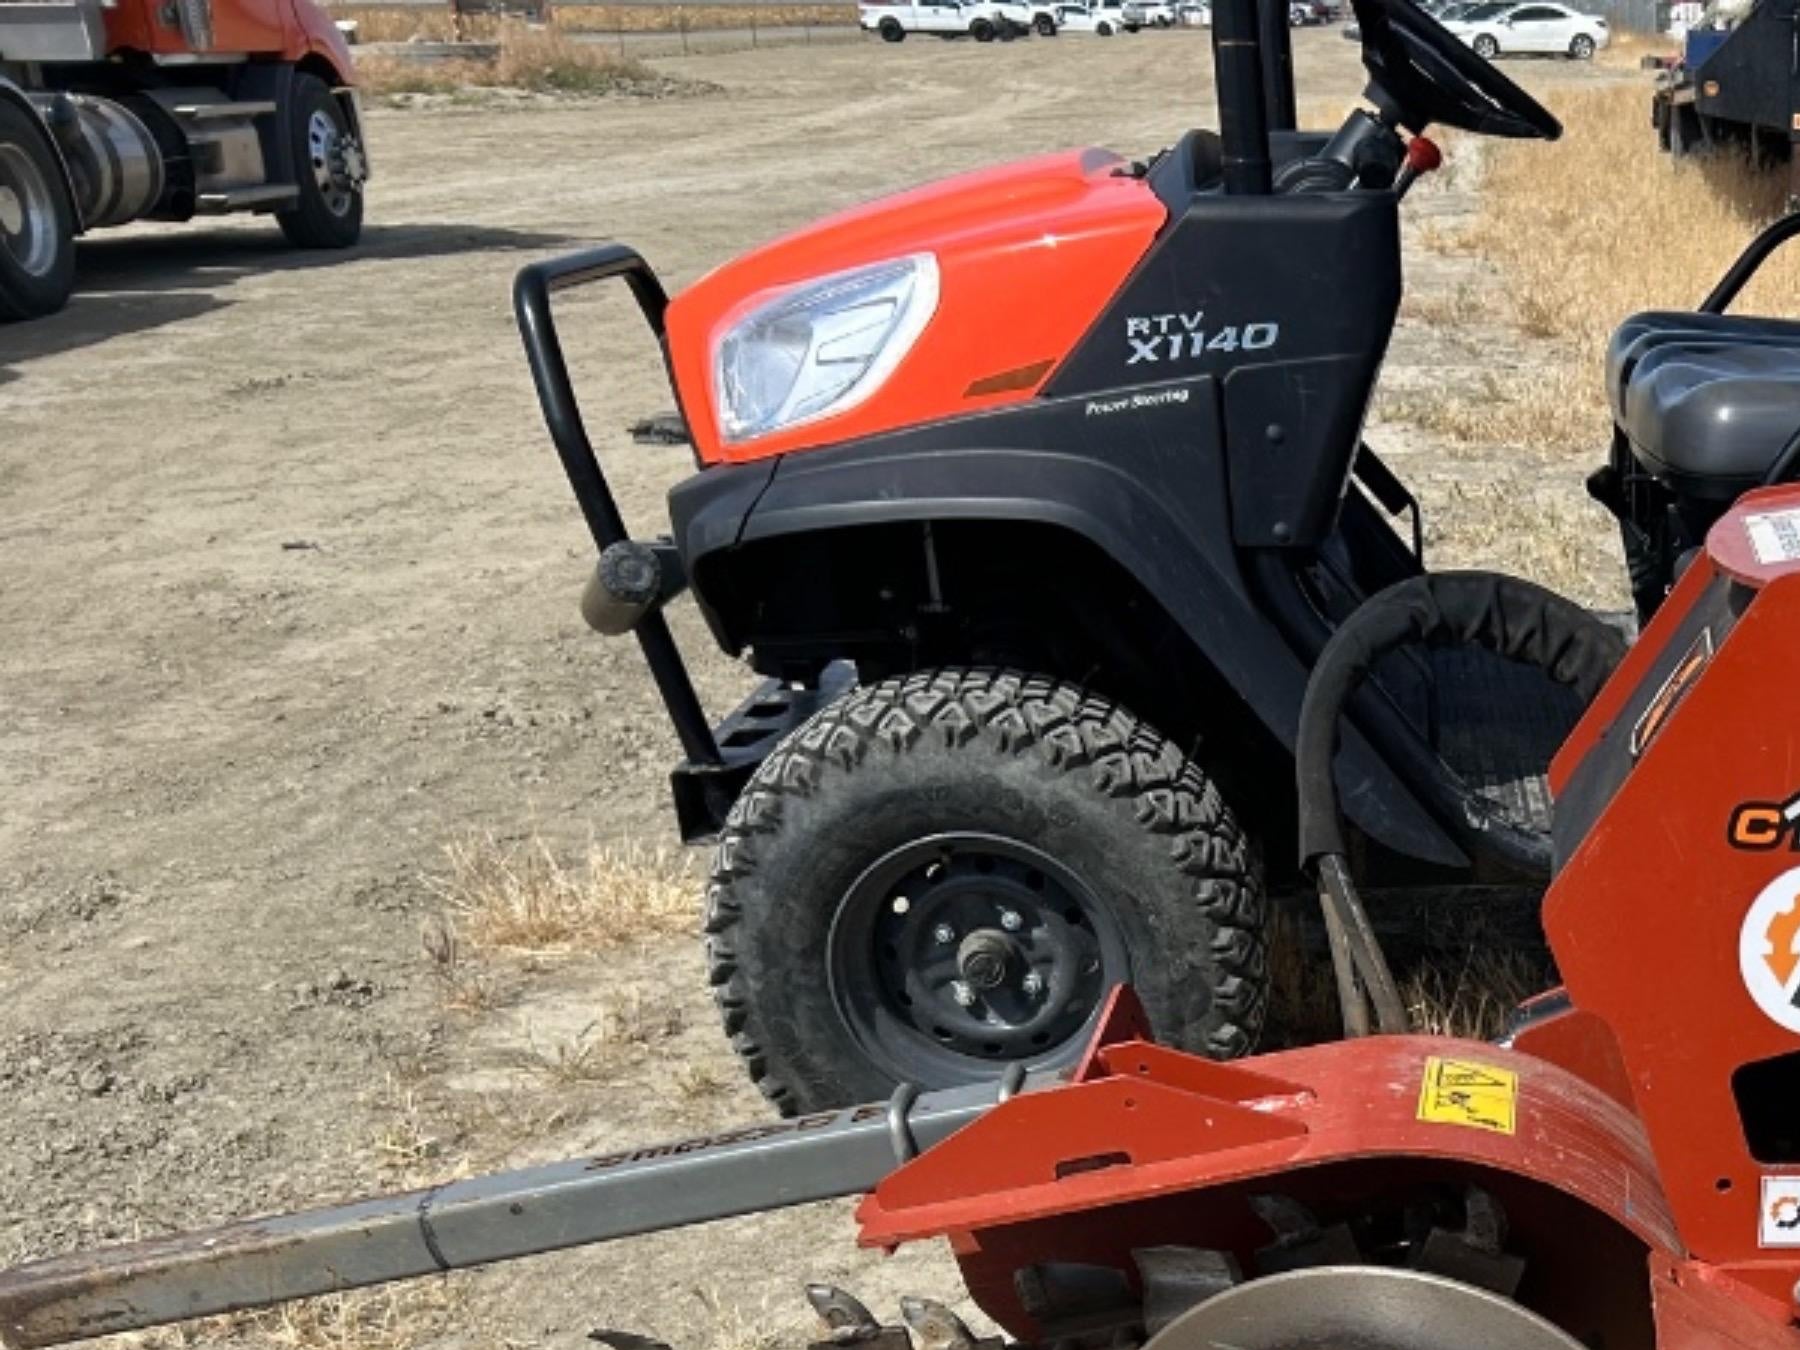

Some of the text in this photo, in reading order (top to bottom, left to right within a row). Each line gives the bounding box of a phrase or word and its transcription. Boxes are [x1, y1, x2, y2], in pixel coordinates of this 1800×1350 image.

[1127, 311, 1203, 337] RTV
[1126, 323, 1279, 364] X1140
[1086, 389, 1189, 415] Power Steering
